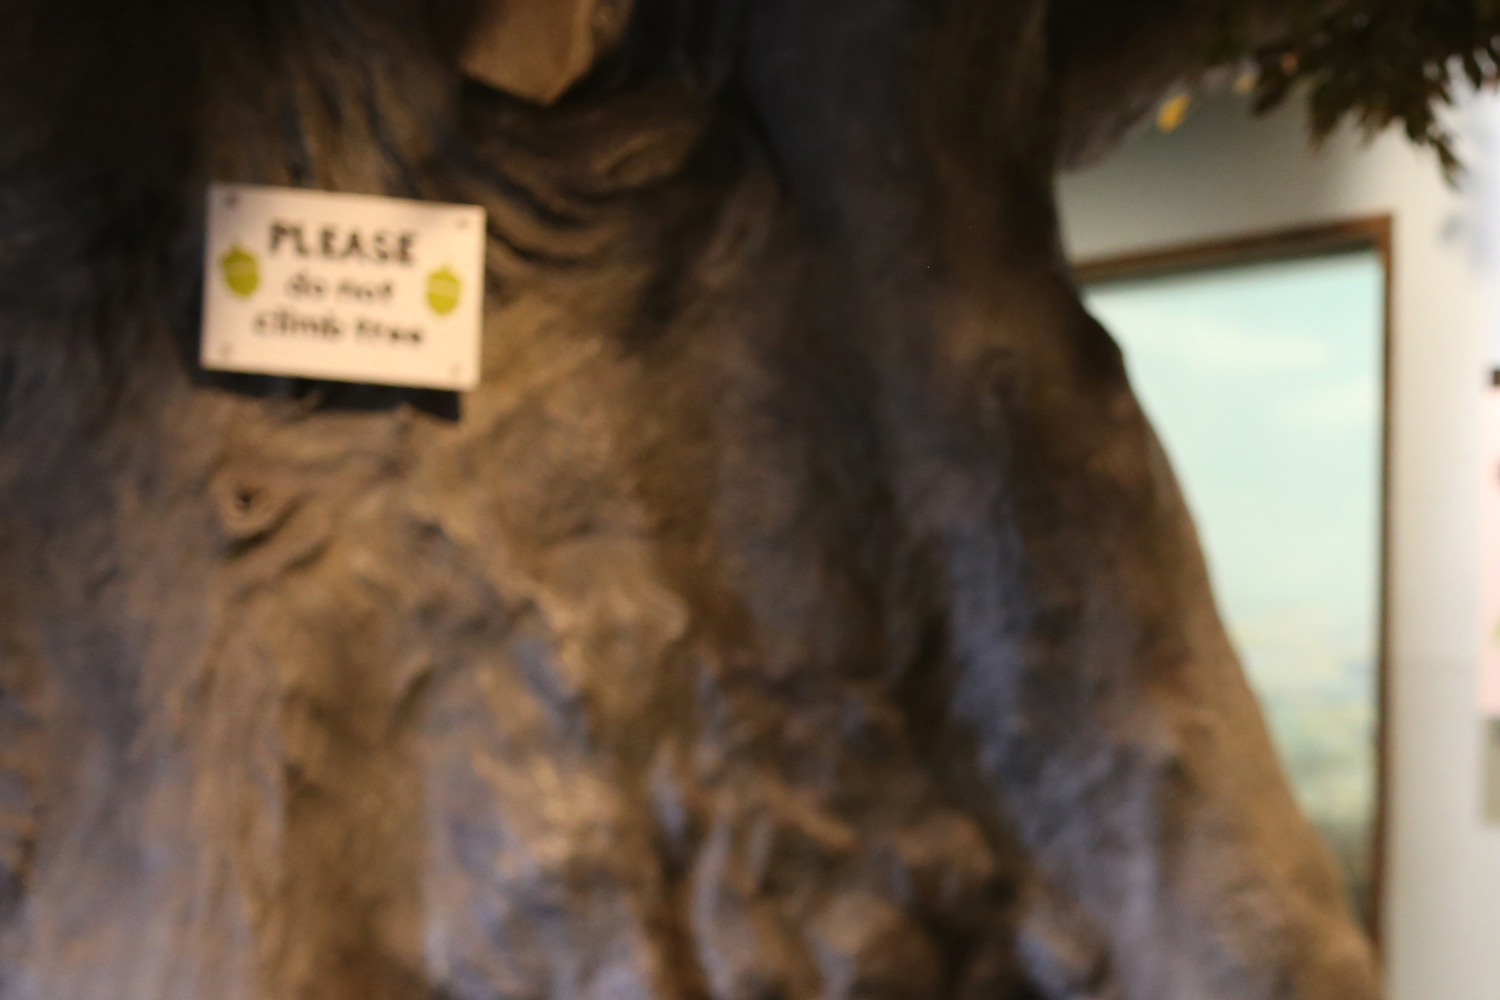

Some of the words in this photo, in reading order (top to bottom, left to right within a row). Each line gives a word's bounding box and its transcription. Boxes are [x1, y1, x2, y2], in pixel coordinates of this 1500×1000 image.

[269, 219, 415, 266] PLEASE
[287, 271, 326, 297] do
[338, 280, 394, 302] not
[254, 308, 340, 339] climb
[356, 320, 422, 345] tree
